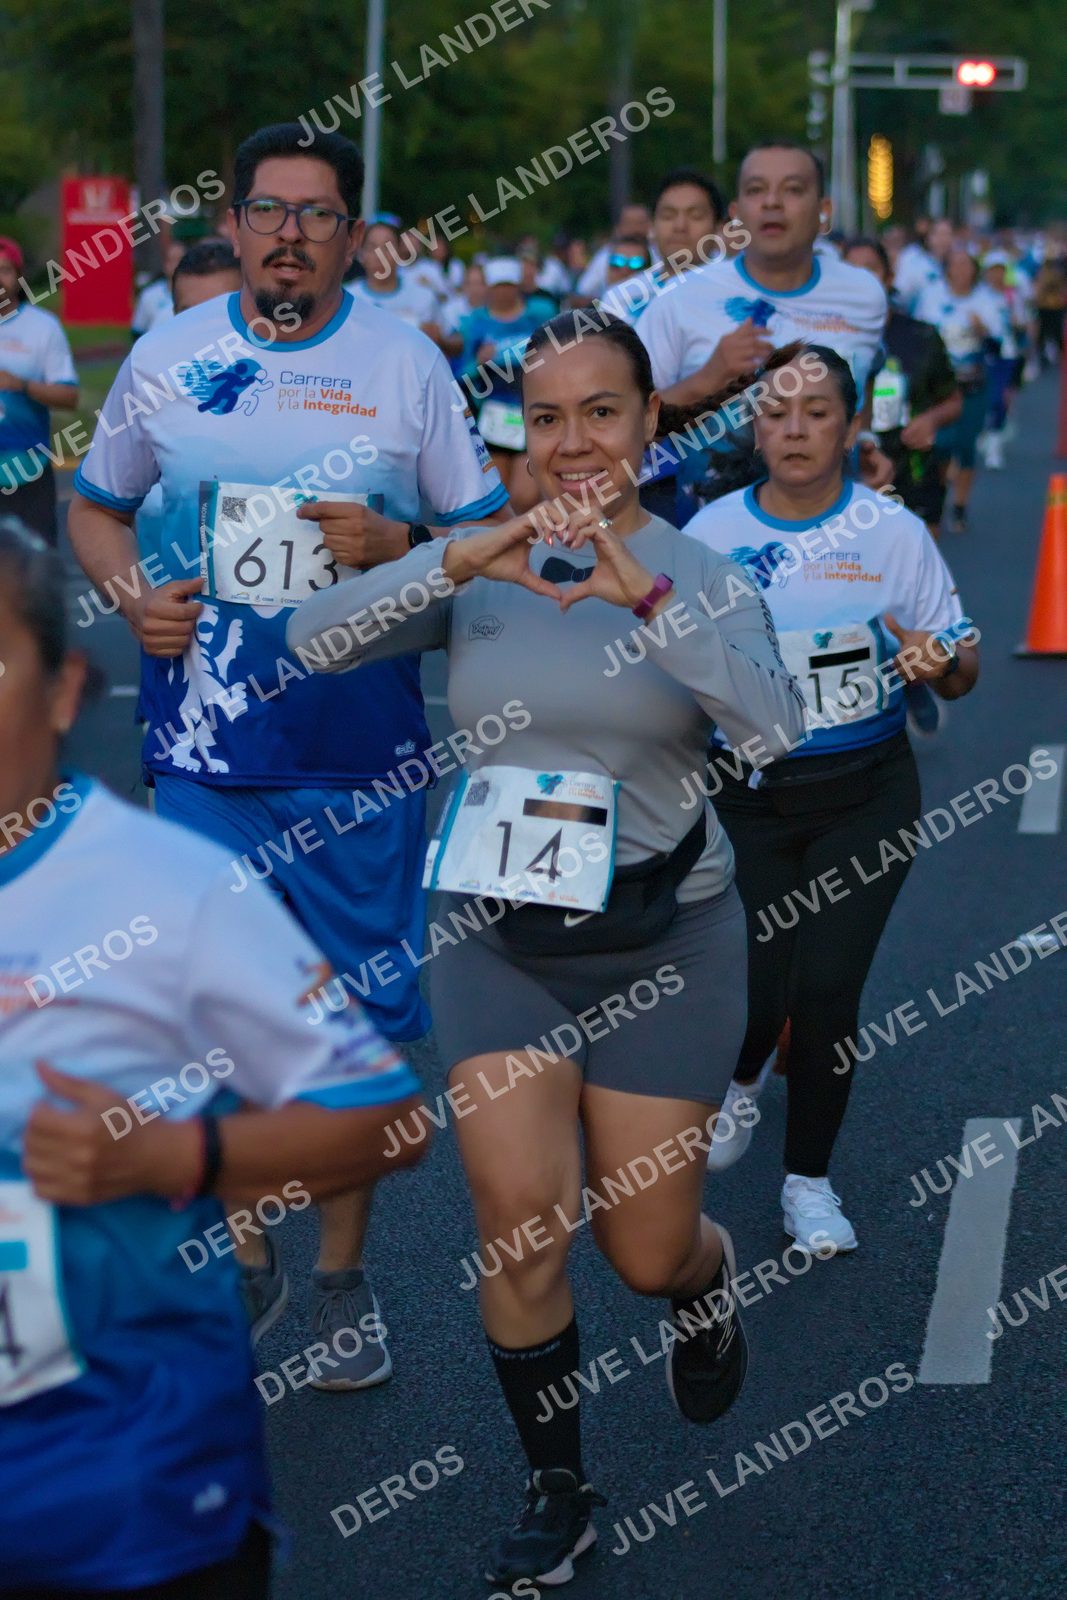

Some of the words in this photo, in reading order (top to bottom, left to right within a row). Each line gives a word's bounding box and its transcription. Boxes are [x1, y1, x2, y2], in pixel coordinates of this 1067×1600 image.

[281, 371, 351, 389] Carrera
[279, 388, 301, 400] por
[305, 387, 316, 398] la
[320, 388, 352, 401] Vida
[277, 401, 285, 411] y
[288, 398, 299, 410] la
[303, 400, 377, 417] Integridad
[837, 562, 862, 571] Vida
[824, 571, 882, 583] Integridad
[808, 667, 861, 713] 15
[496, 820, 562, 884] 14
